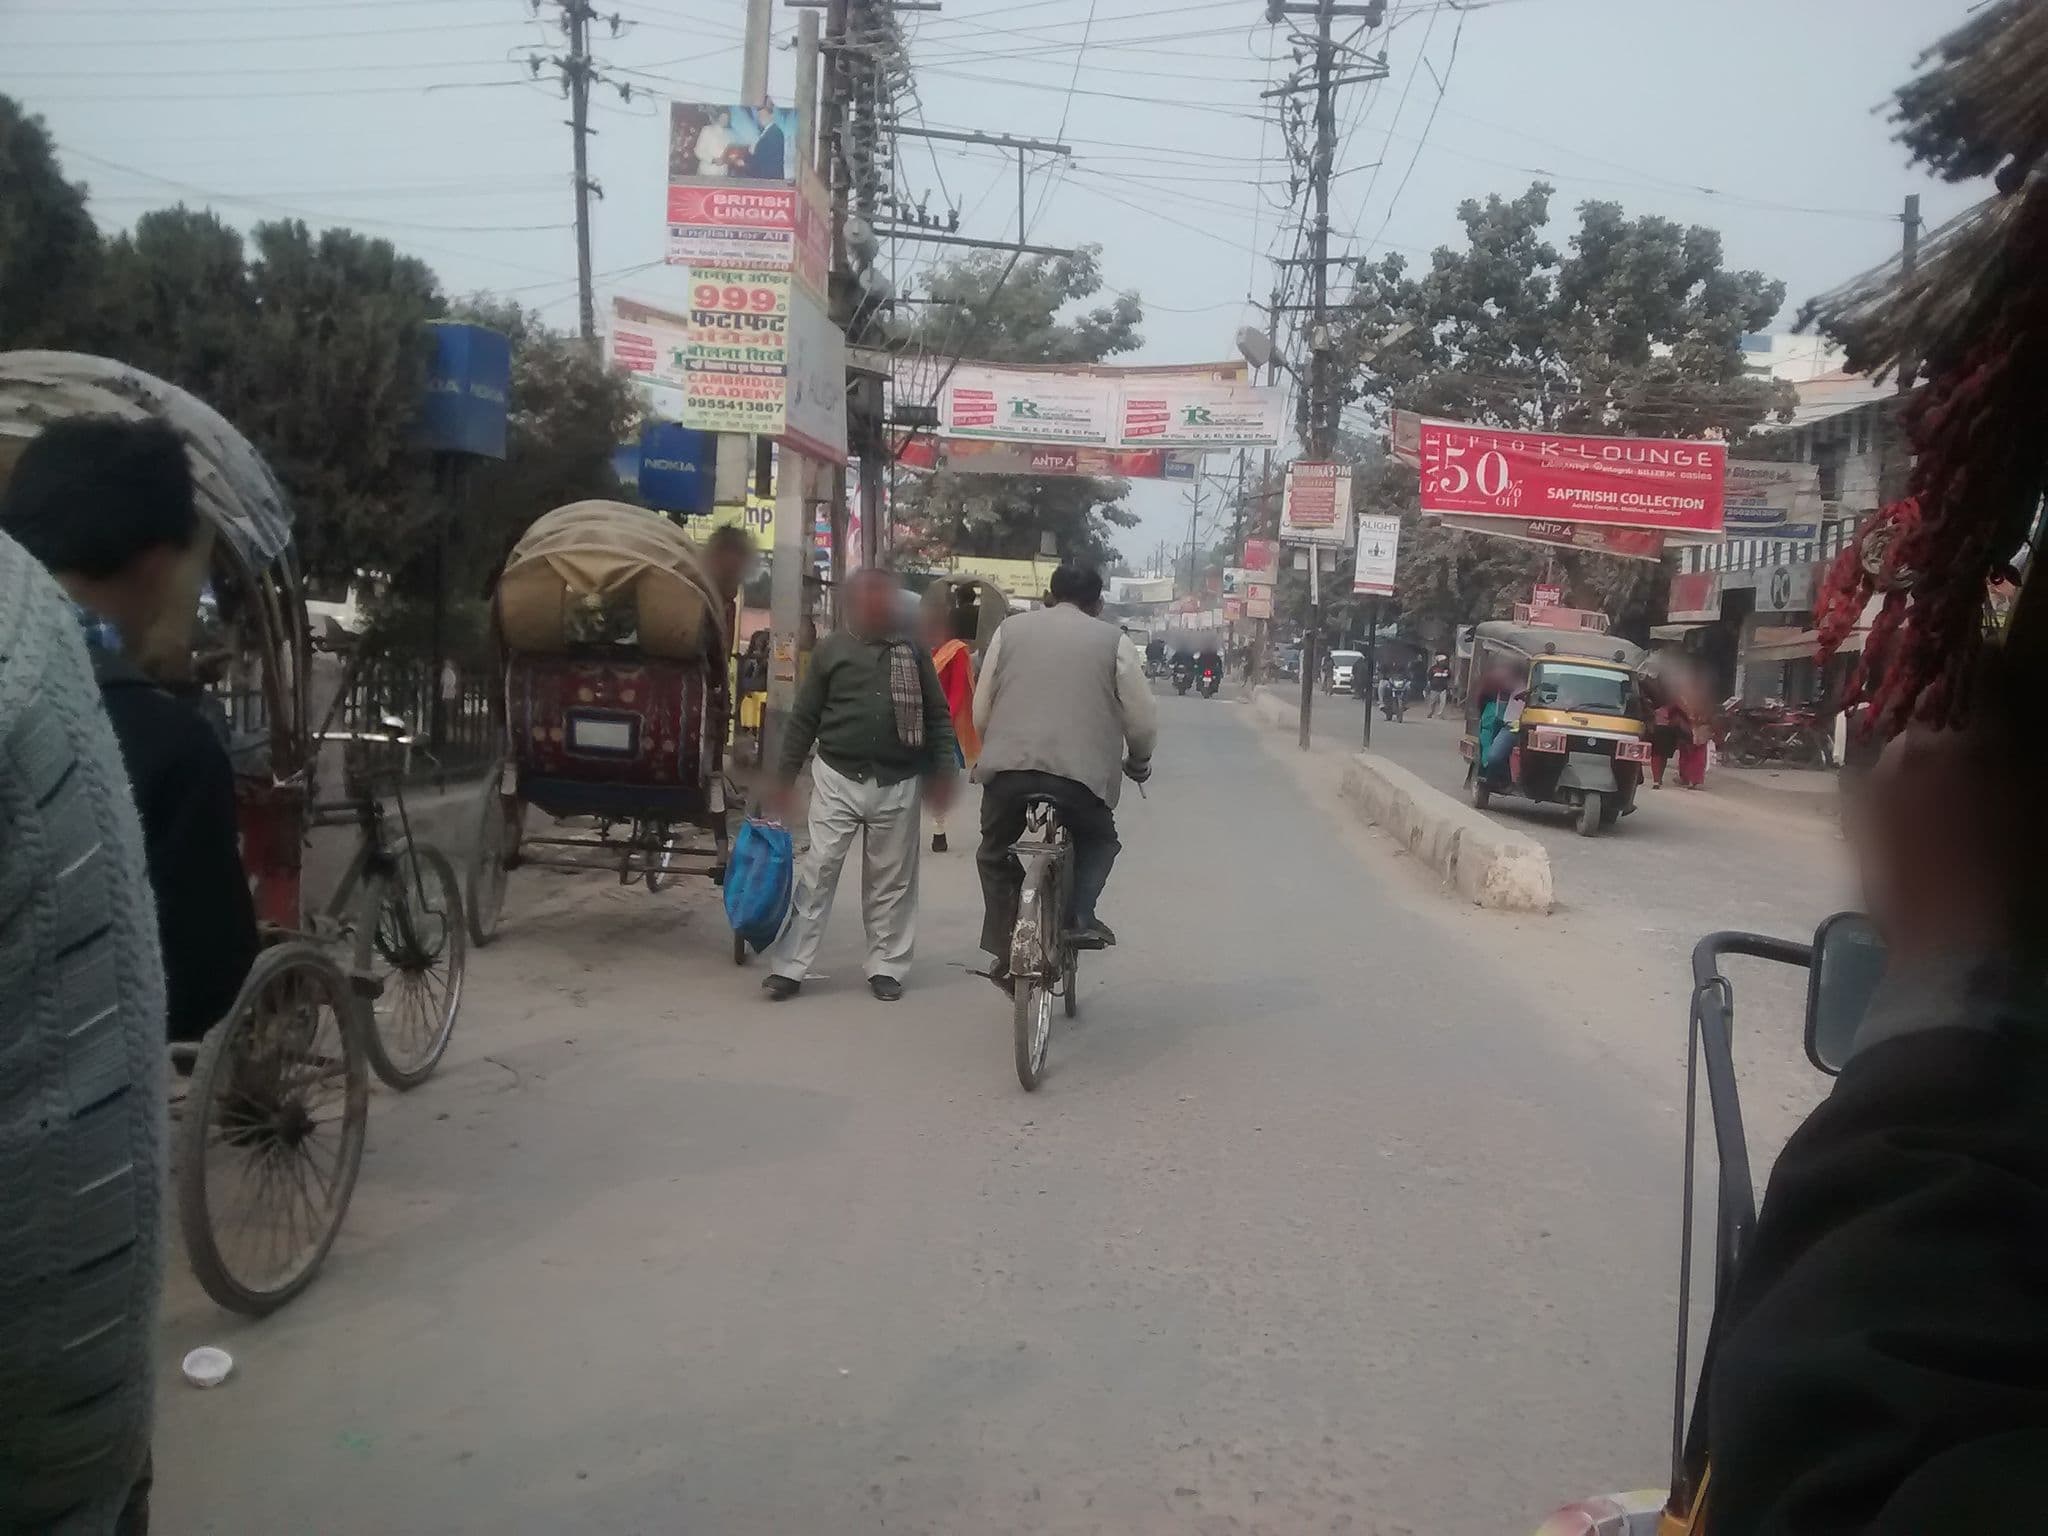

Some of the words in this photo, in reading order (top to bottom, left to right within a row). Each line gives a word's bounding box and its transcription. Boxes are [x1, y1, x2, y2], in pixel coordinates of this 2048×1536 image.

[713, 194, 790, 208] BRITISH
[714, 207, 789, 221] LINGUA
[763, 231, 783, 241] All
[694, 284, 776, 312] 999
[688, 373, 784, 389] CAMBRIDGE
[689, 385, 783, 401] ACADEMY
[1540, 441, 1713, 468] K-LOUNGE
[644, 458, 697, 473] NOKIA
[1425, 432, 1441, 494] SALE
[1546, 487, 1617, 504] SAPTRISHI
[1620, 491, 1705, 511] COLLECTION
[1360, 520, 1398, 532] ALIGHT
